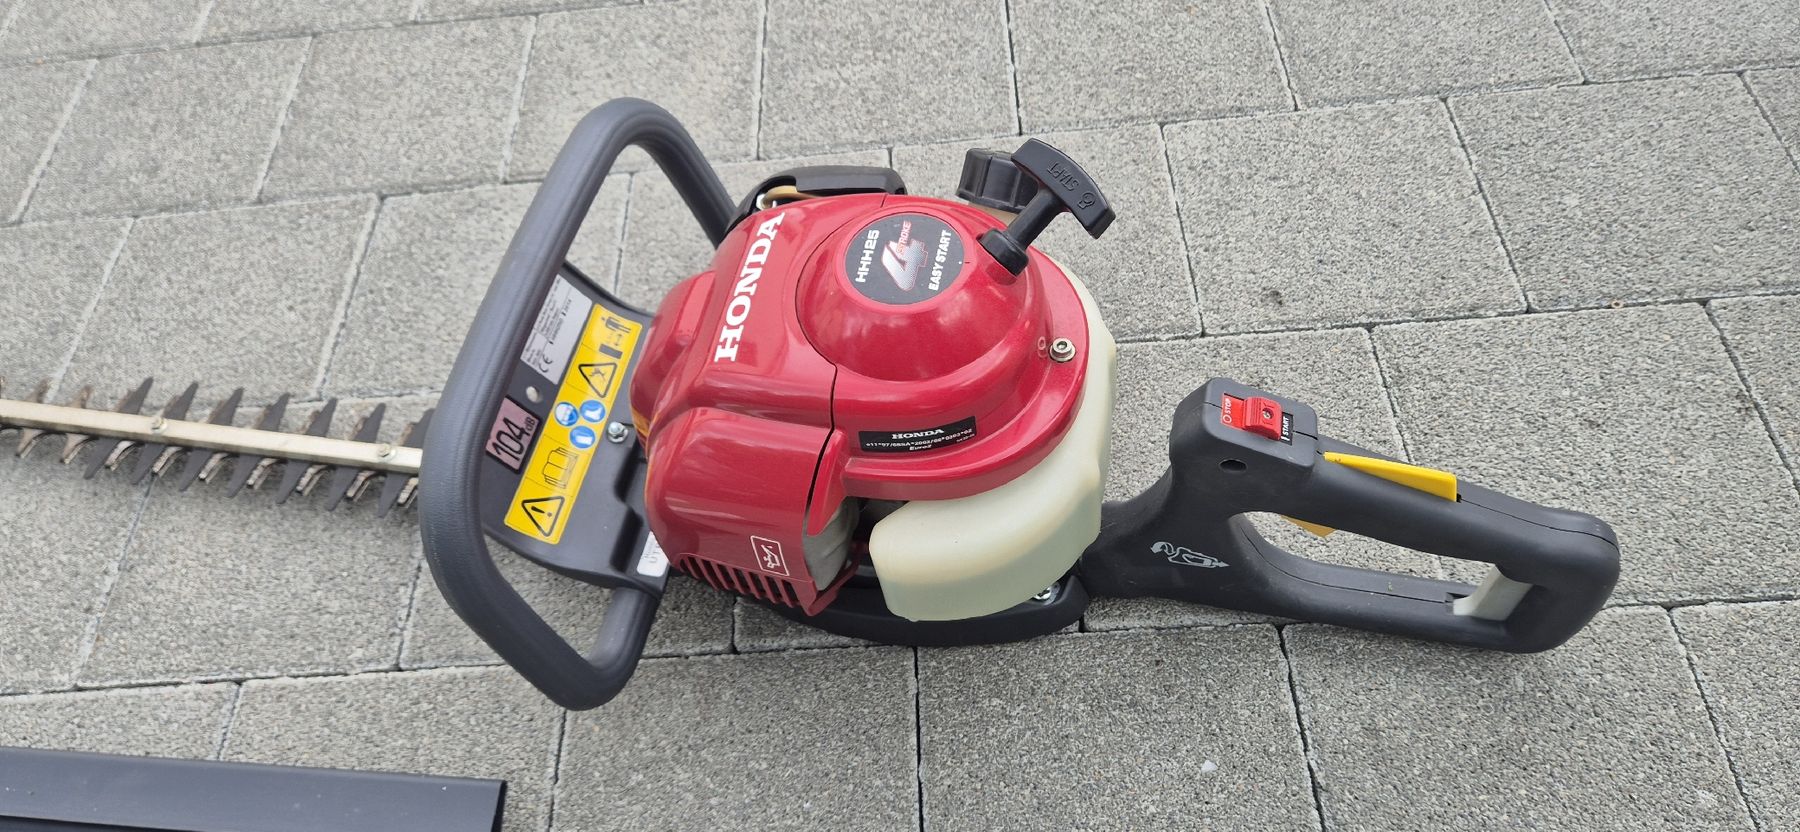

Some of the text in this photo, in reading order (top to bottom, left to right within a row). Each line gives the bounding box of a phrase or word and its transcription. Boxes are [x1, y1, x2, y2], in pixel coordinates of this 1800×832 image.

[1047, 163, 1079, 191] START
[855, 229, 880, 283] HHH25
[928, 229, 952, 291] EASY START
[714, 212, 785, 362] HONDA
[1224, 398, 1232, 414] STOP
[492, 416, 535, 461] 104 dB
[892, 428, 945, 440] HONDA
[1282, 416, 1290, 436] START
